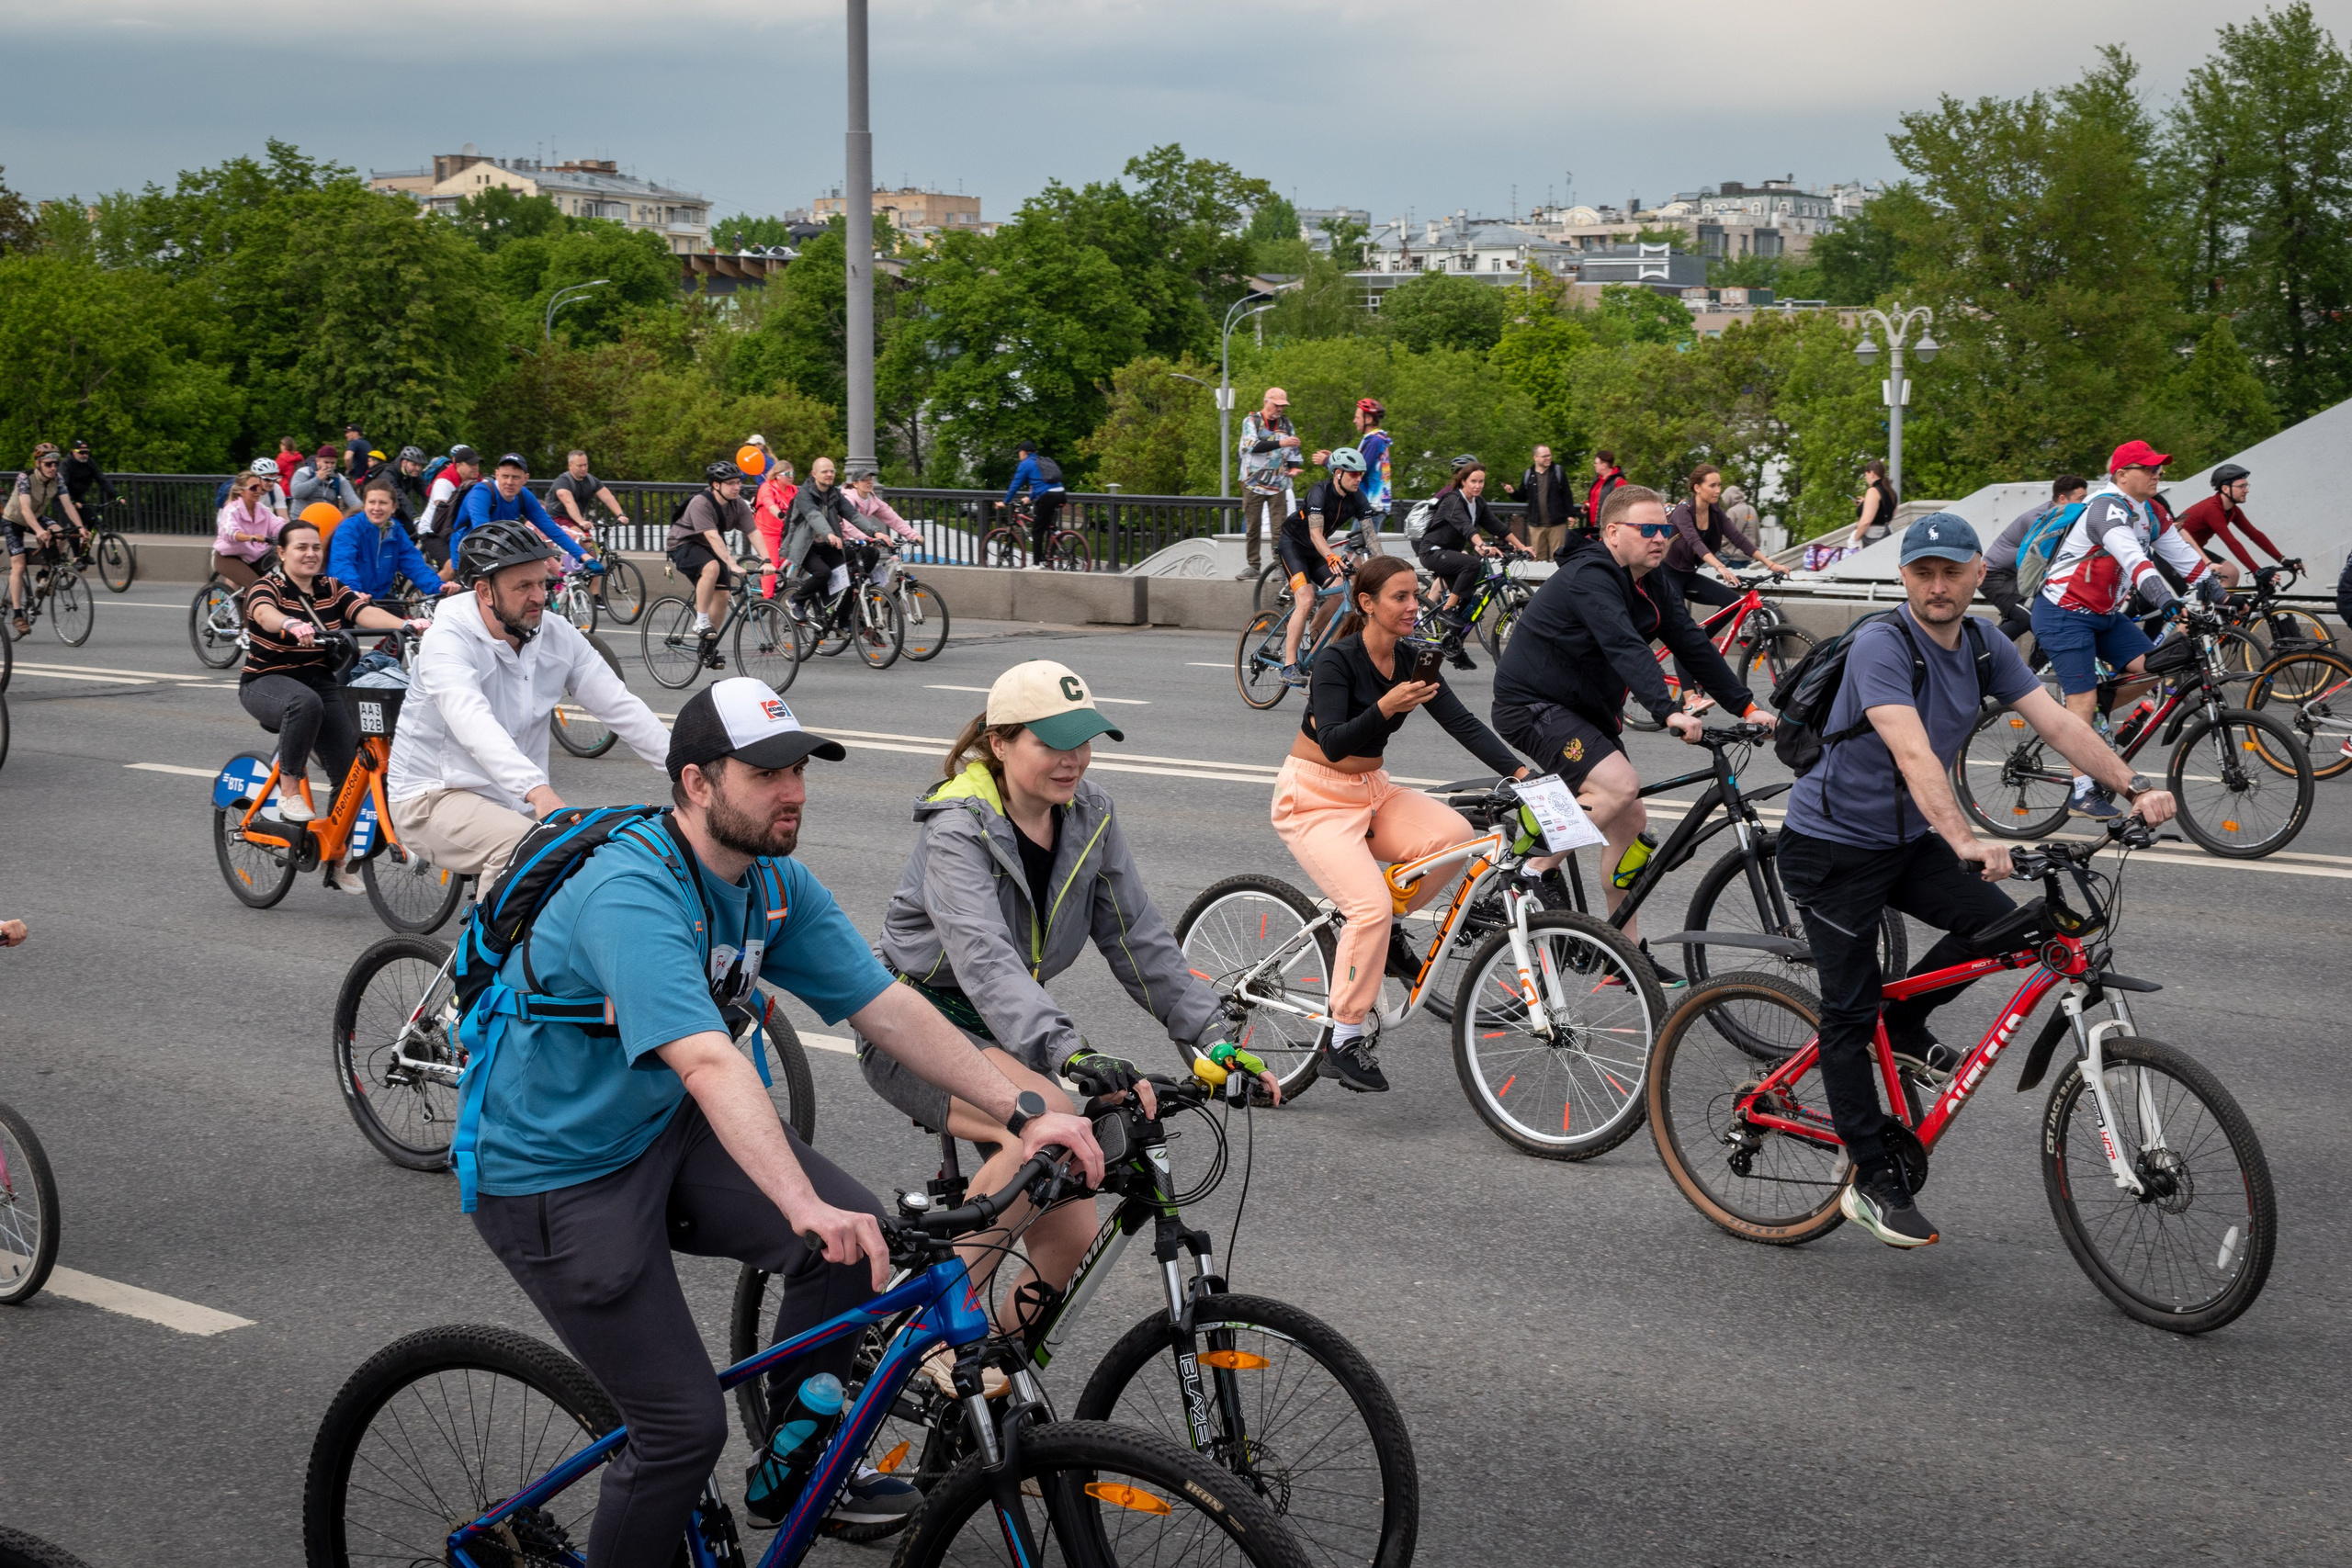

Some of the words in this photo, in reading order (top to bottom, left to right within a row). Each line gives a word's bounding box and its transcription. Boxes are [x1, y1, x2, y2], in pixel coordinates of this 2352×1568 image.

[1059, 676, 1084, 702] C
[228, 776, 245, 792] ВТБ
[335, 761, 364, 818] Велобай
[1971, 959, 1992, 969] RIOT
[1995, 952, 2023, 963] ETE
[413, 1063, 464, 1076] FUJ
[2060, 1068, 2082, 1096] RABB
[2049, 1095, 2064, 1128] JACK
[2046, 1128, 2055, 1155] CST
[1728, 1217, 1788, 1235] MAXXIS
[1061, 1215, 1114, 1303] JAMIS
[1054, 1303, 1077, 1338] JAMIS
[1179, 1352, 1213, 1447] BLAZE
[1184, 1480, 1225, 1513] IKON
